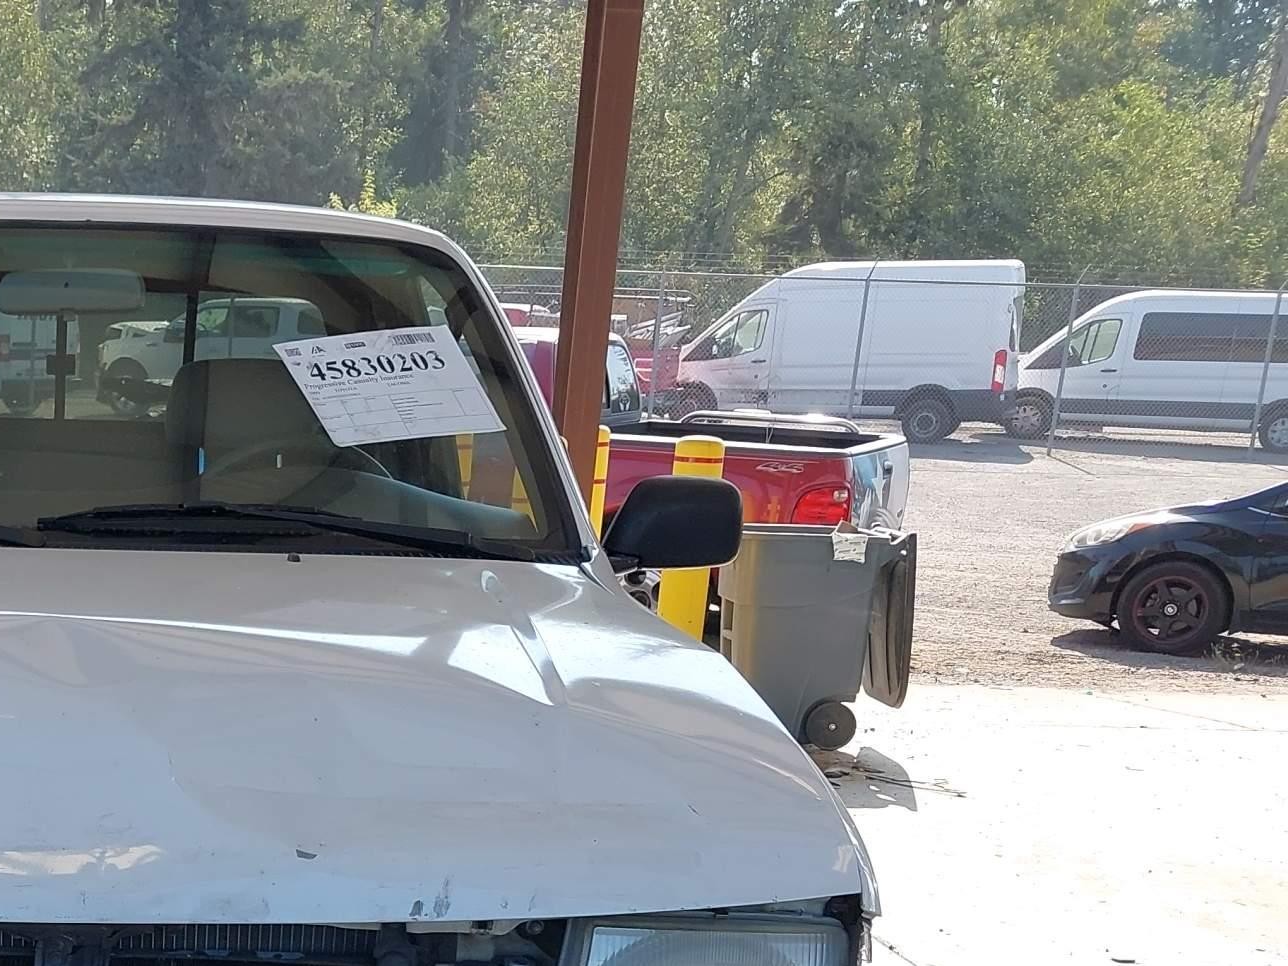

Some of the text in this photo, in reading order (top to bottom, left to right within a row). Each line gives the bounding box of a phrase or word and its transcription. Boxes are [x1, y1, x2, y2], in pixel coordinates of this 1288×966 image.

[310, 350, 446, 381] 45830203
[304, 373, 415, 390] Progressive Casualty Insurance
